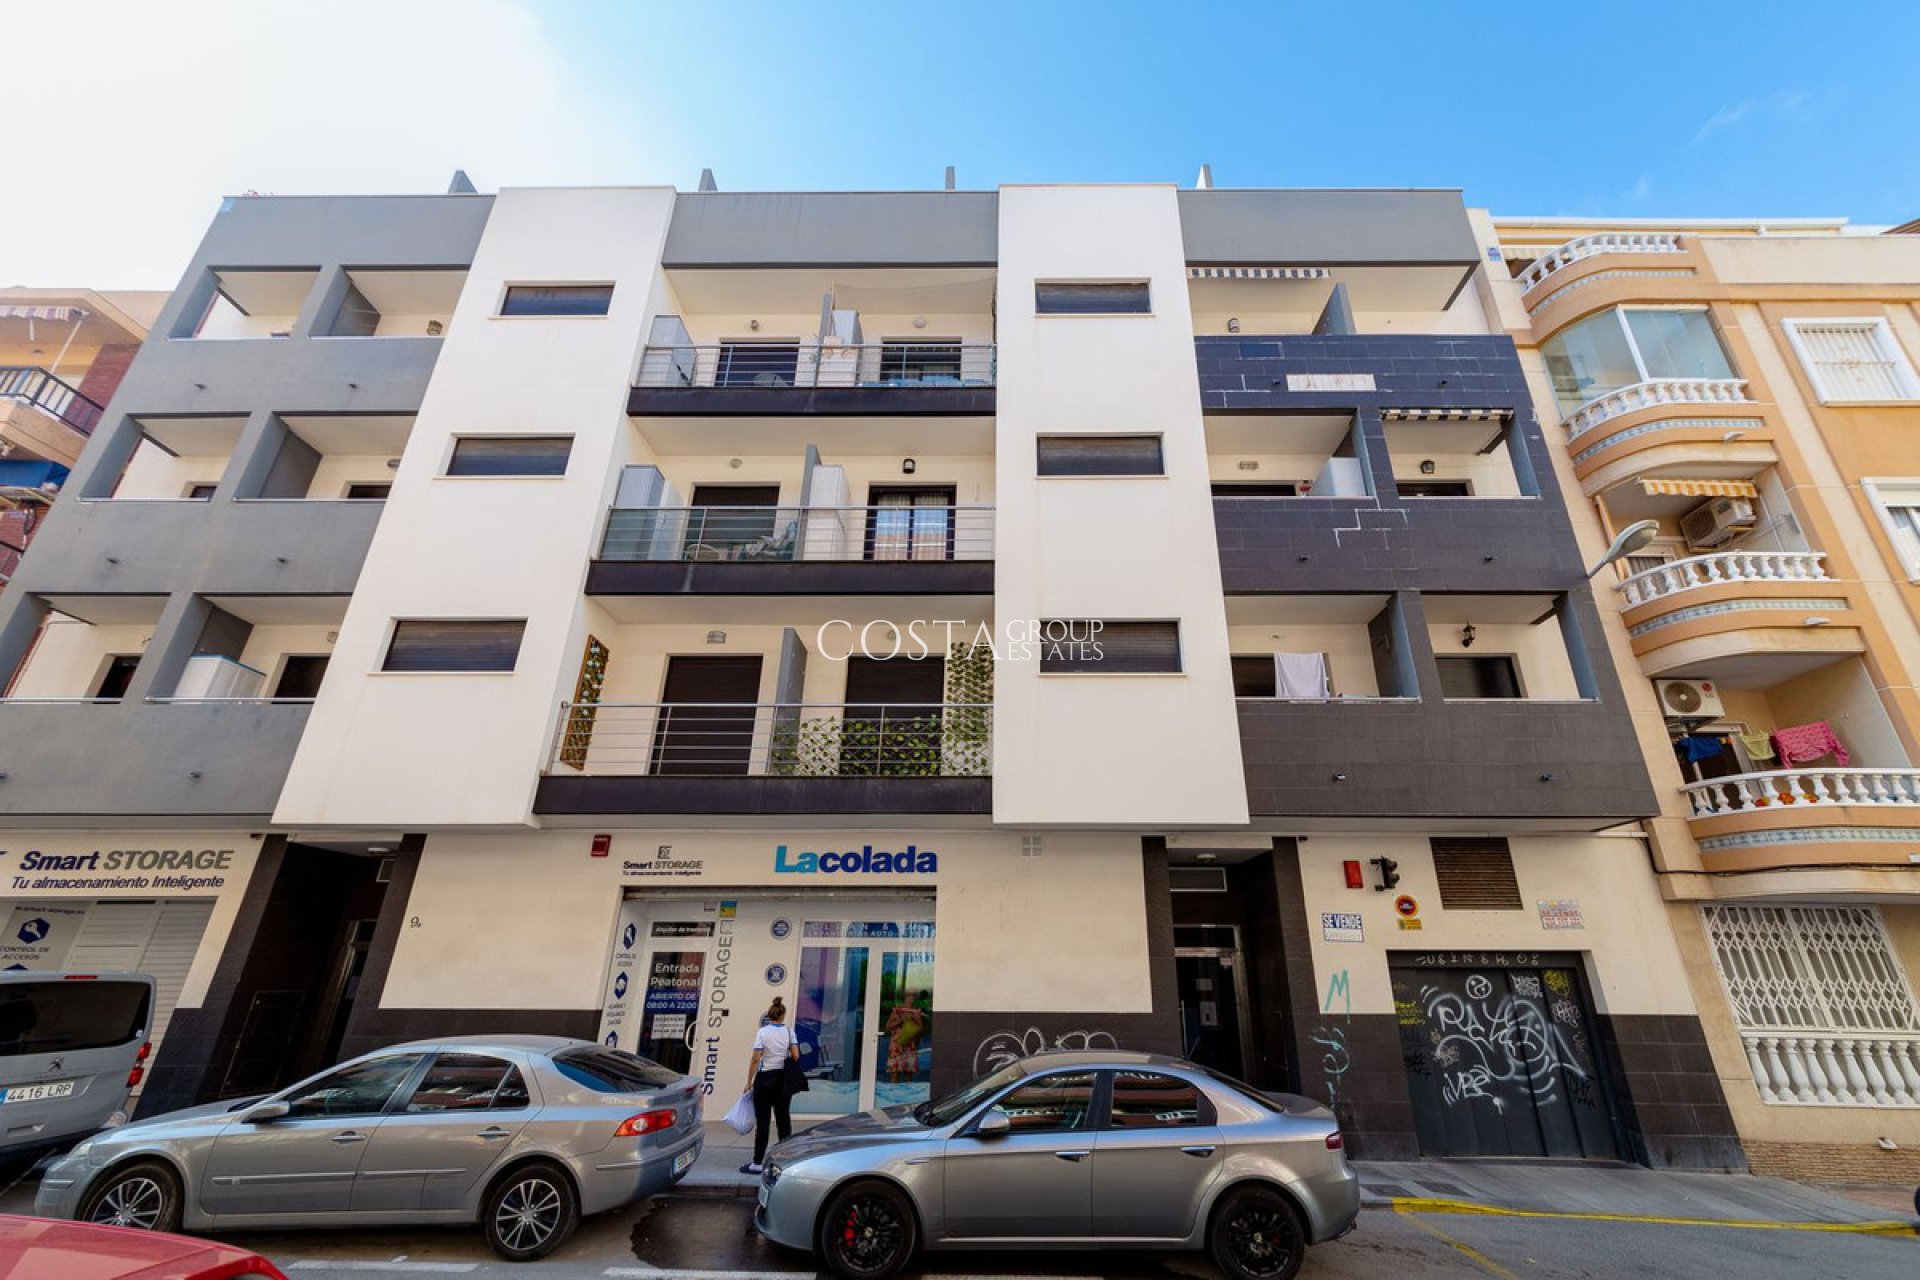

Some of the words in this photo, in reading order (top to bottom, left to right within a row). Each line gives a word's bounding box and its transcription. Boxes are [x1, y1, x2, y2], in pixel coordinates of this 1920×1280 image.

[19, 850, 100, 871] Smart
[103, 850, 235, 870] STORAGE
[623, 860, 652, 870] Smart
[654, 860, 704, 870] STORAGE
[774, 845, 938, 873] Lacolada
[12, 876, 30, 889] Tu
[32, 876, 149, 889] almacenamiento
[1322, 914, 1334, 928] SE
[1334, 915, 1362, 928] VENDE
[655, 963, 700, 974] Entrada
[650, 977, 702, 987] Peatonal
[707, 936, 734, 1028] STORAGE
[702, 1036, 721, 1095] Smart
[8, 1086, 44, 1100] 4416
[47, 1082, 71, 1096] LRP
